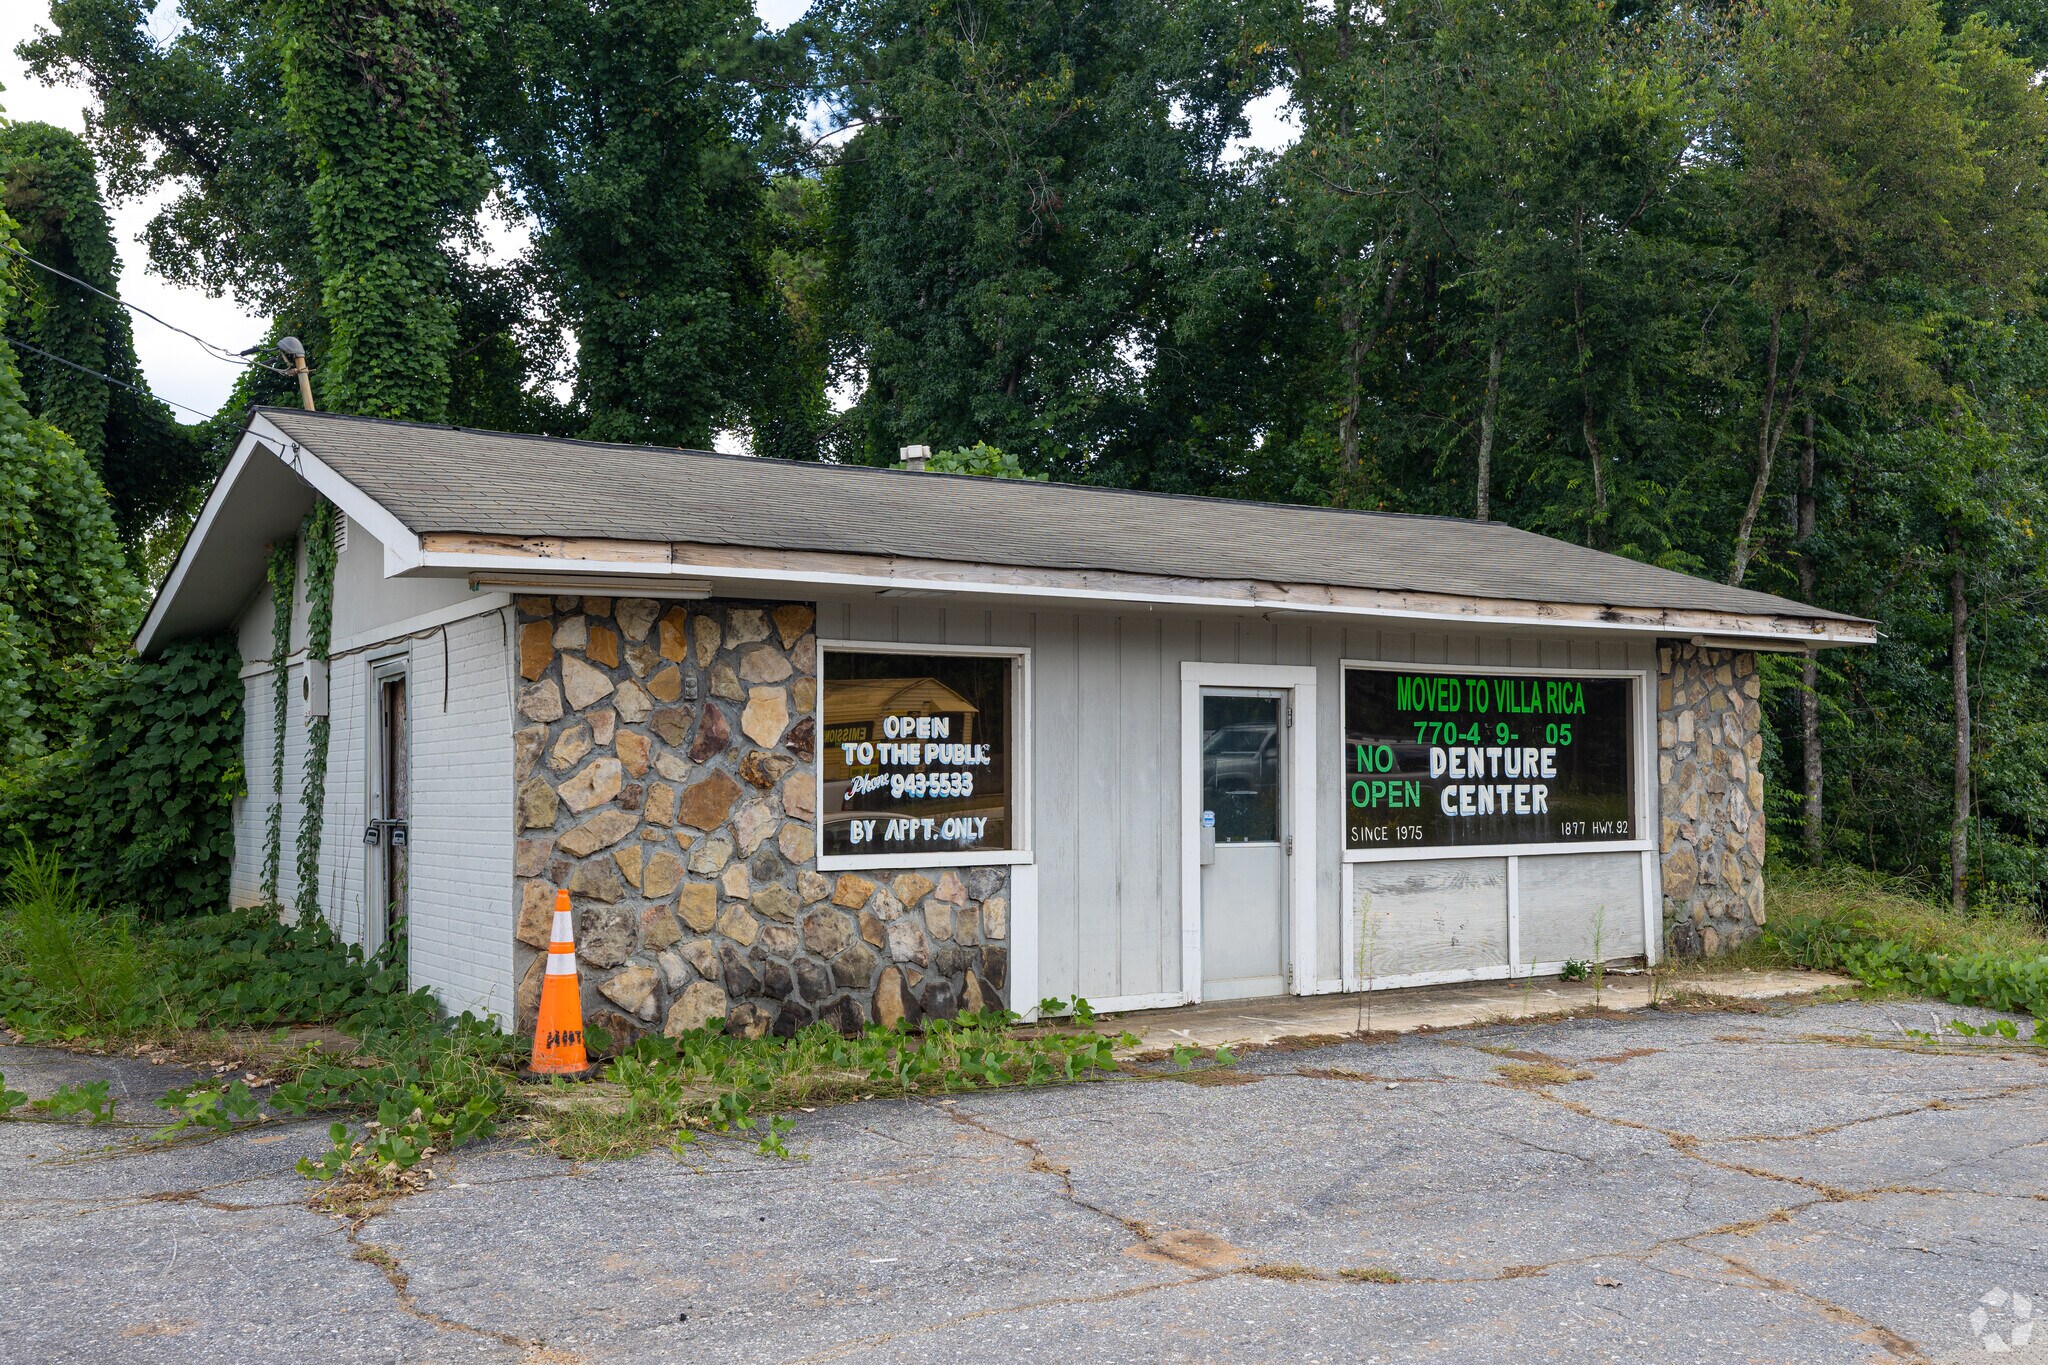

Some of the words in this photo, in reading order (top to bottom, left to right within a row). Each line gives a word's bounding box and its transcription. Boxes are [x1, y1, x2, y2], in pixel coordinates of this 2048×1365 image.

[1397, 676, 1461, 712] MOVED
[1465, 679, 1489, 713] TO
[1494, 679, 1543, 714] VILLA
[1546, 681, 1586, 715] RICA
[883, 715, 950, 739] OPEN
[841, 742, 875, 766] TO
[876, 742, 921, 766] THE
[924, 743, 991, 766] PUBLIC
[1357, 745, 1393, 773] NO
[1429, 747, 1557, 779] DENTURE
[844, 772, 890, 801] Phone
[890, 771, 974, 799] 943-5533
[1351, 780, 1421, 808] OPEN
[1441, 784, 1549, 817] CENTER
[850, 819, 876, 845] BY
[884, 818, 939, 841] APPT.
[941, 816, 988, 841] ONLY
[1351, 826, 1389, 842] SINCE
[1395, 825, 1423, 840] 1975
[1561, 821, 1586, 836] 1897
[1592, 821, 1614, 834] HWY.
[1616, 820, 1629, 834] 92
